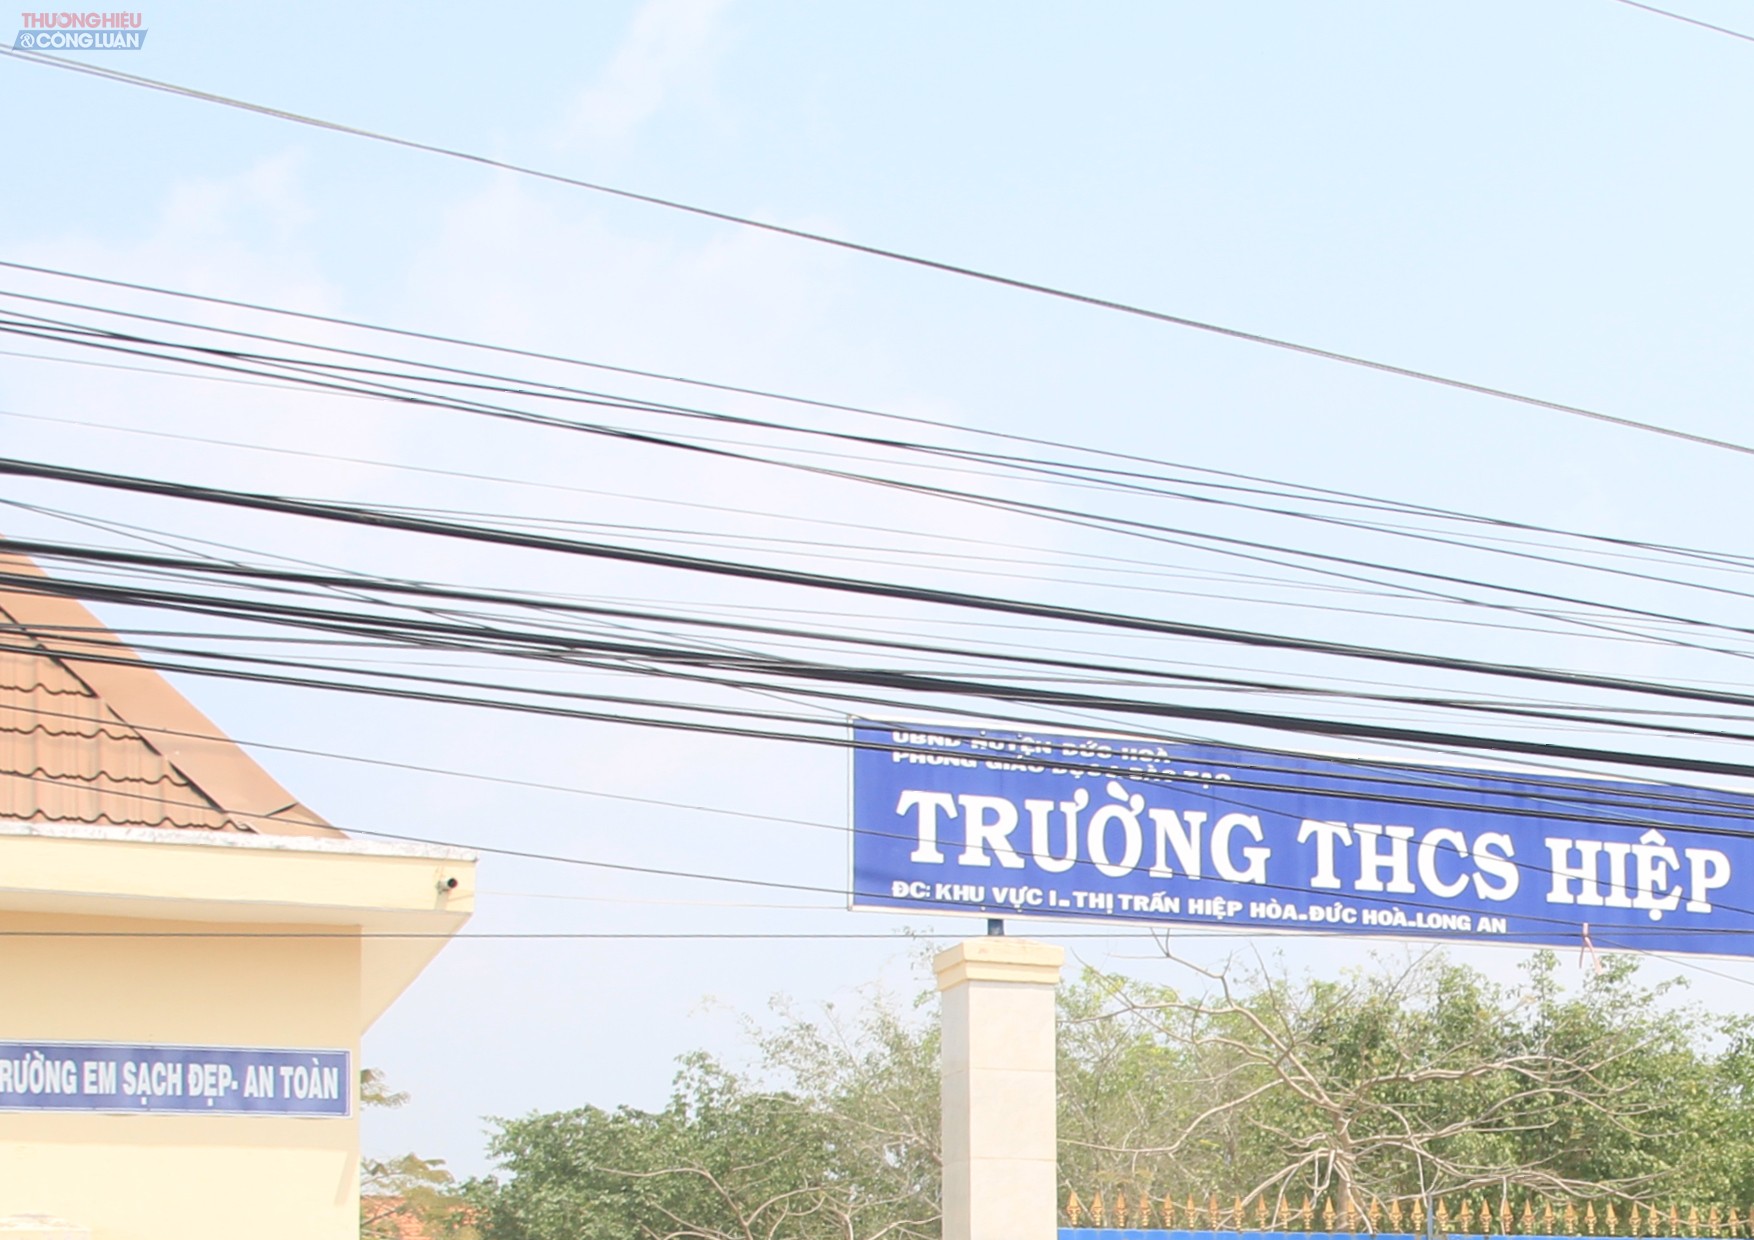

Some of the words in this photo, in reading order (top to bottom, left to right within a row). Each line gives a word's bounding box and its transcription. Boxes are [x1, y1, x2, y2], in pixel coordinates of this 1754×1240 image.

[892, 731, 961, 747] UBND
[896, 781, 1271, 884] TRƯỜNG
[1297, 819, 1520, 901] THCS
[1545, 828, 1731, 921] HIỆP
[892, 880, 931, 898] ĐC:
[936, 883, 985, 902] KHU
[992, 886, 1043, 908] VỰC
[1118, 891, 1180, 914] TRẤN
[1188, 896, 1243, 919] HIỆP
[1477, 916, 1507, 933] AN
[84, 1061, 116, 1095] EM
[123, 1062, 182, 1105] SẠCH
[243, 1065, 274, 1099] AN
[280, 1058, 339, 1099] TOÀN
